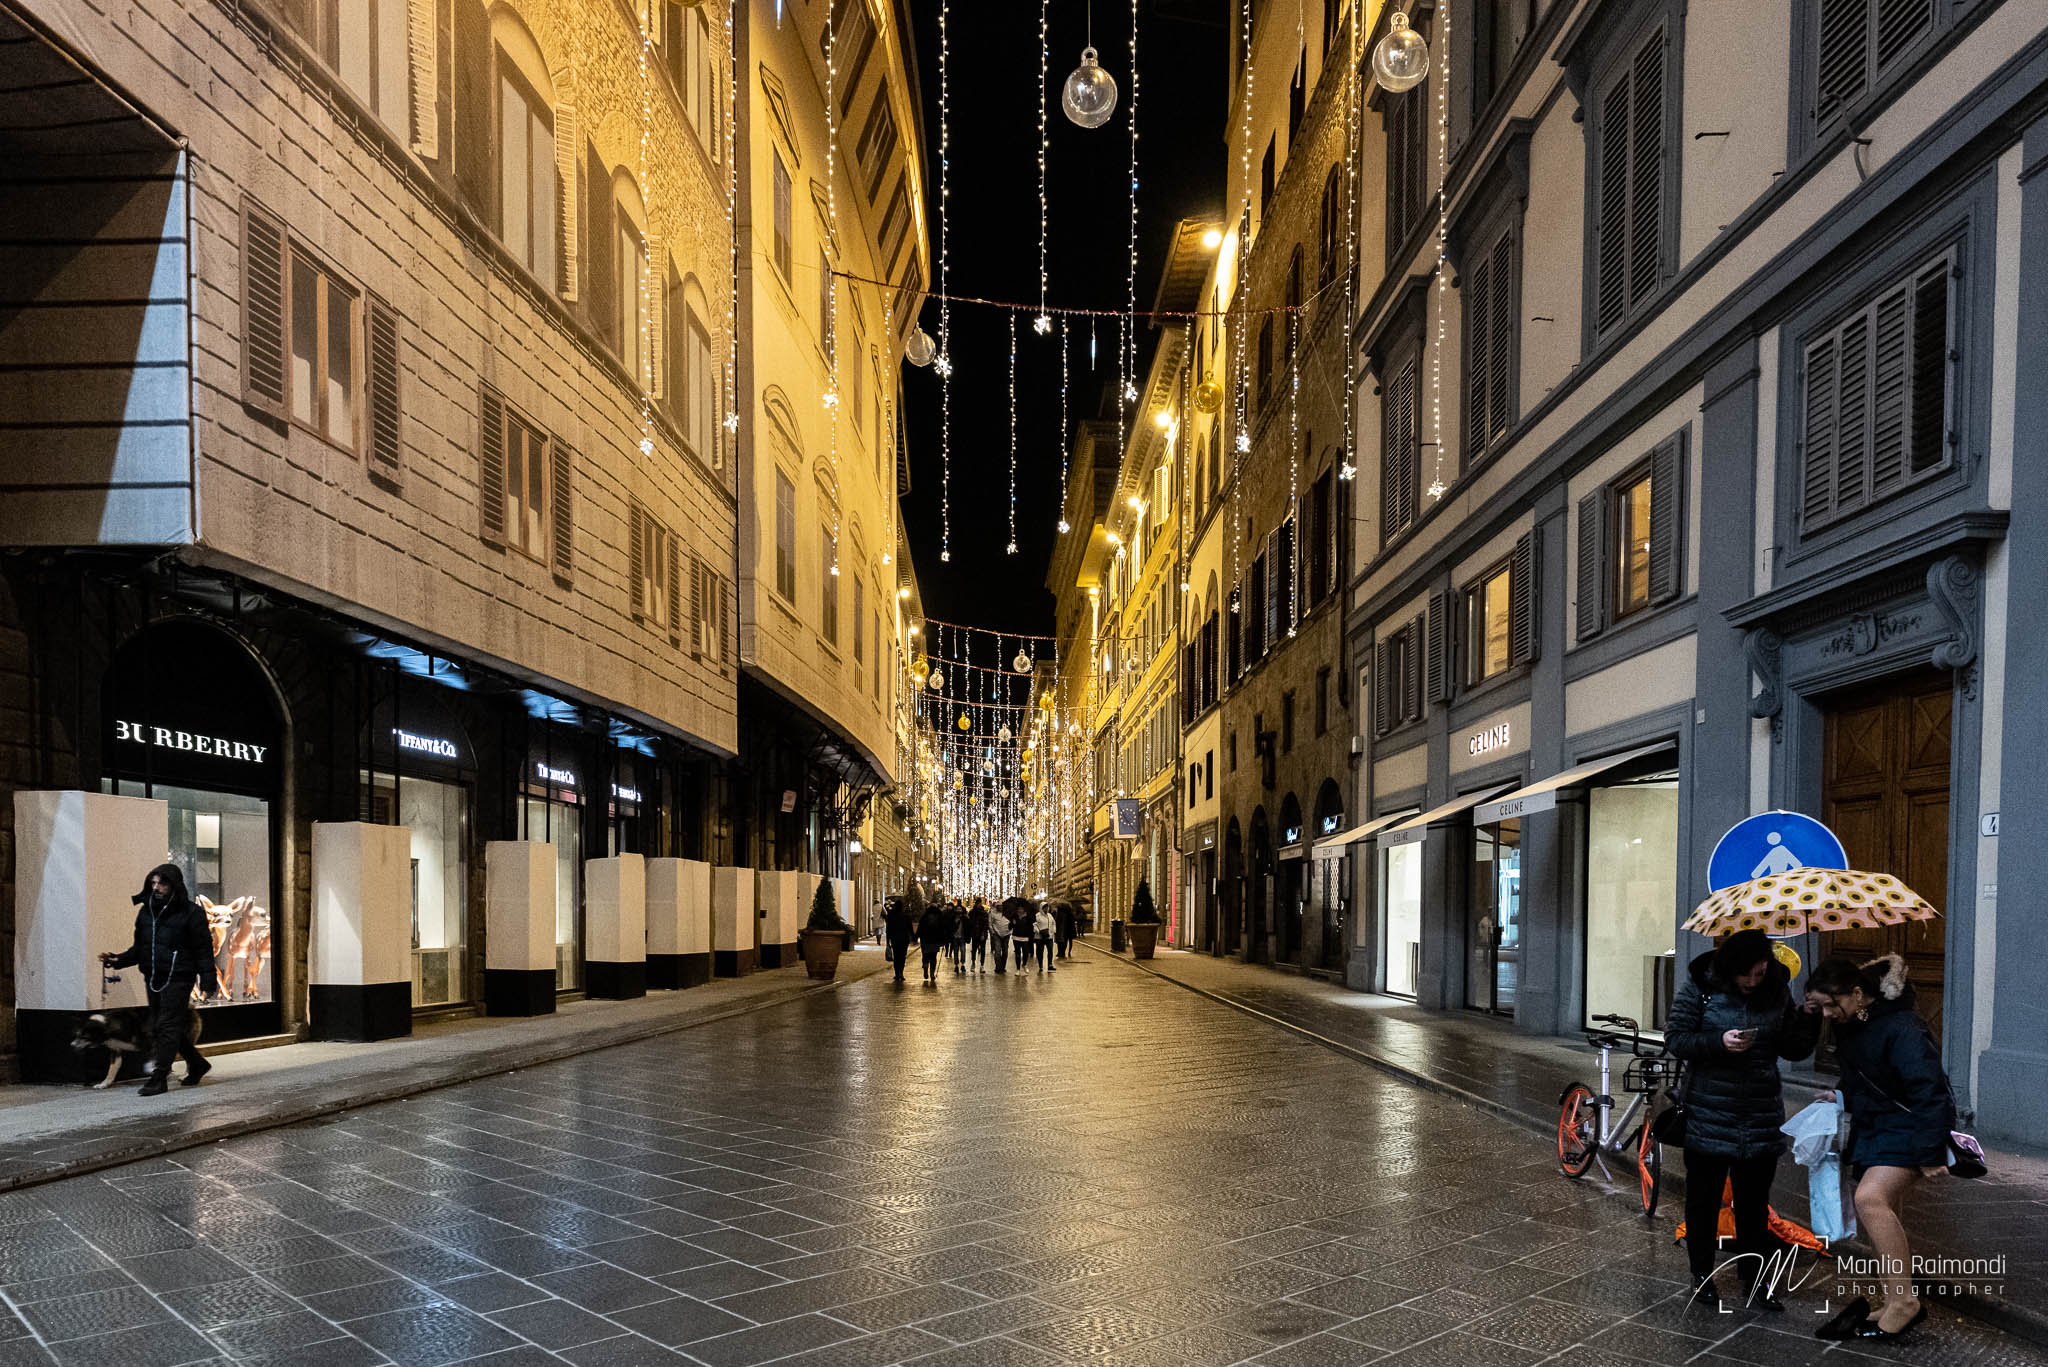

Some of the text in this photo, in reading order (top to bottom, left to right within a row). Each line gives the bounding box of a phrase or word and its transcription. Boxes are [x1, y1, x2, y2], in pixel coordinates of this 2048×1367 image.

[116, 720, 267, 763] BURBERRY
[1468, 723, 1509, 755] CELINE
[1499, 801, 1524, 816] CELINE
